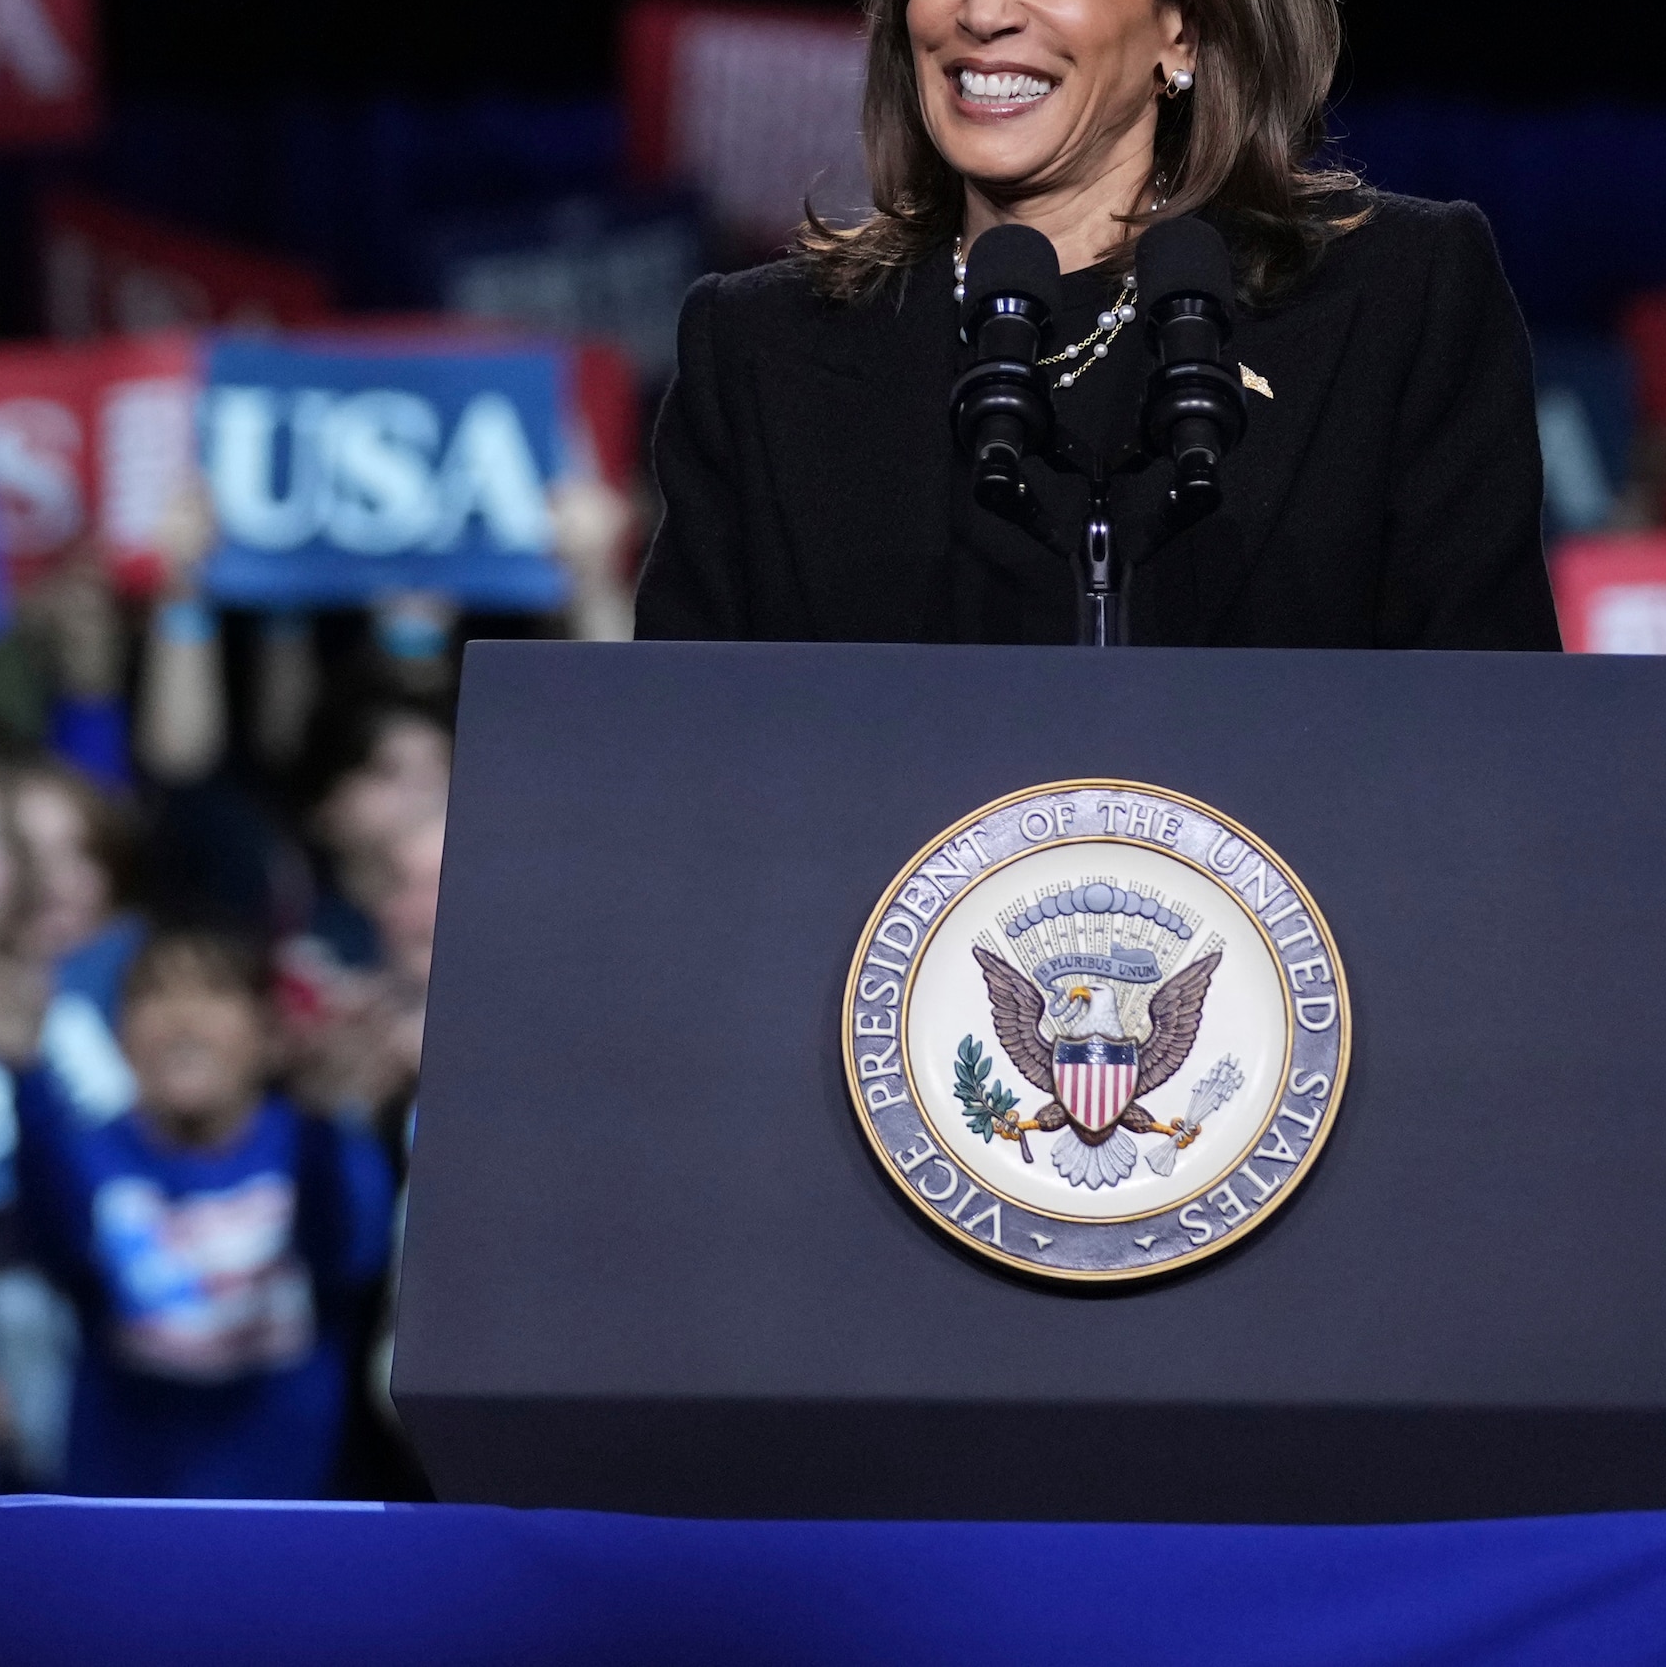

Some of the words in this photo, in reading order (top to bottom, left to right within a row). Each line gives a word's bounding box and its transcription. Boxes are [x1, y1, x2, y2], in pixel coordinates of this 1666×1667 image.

[201, 381, 549, 557] USA
[1019, 802, 1076, 843] OF
[1097, 799, 1184, 846] THE
[855, 825, 992, 1113] PRESIDENT
[1049, 956, 1112, 972] PLURIBUS
[1118, 963, 1157, 978] UNUM
[1206, 825, 1337, 1034] UNITED
[897, 1131, 1004, 1246] VICE
[1177, 1067, 1330, 1246] STATES
